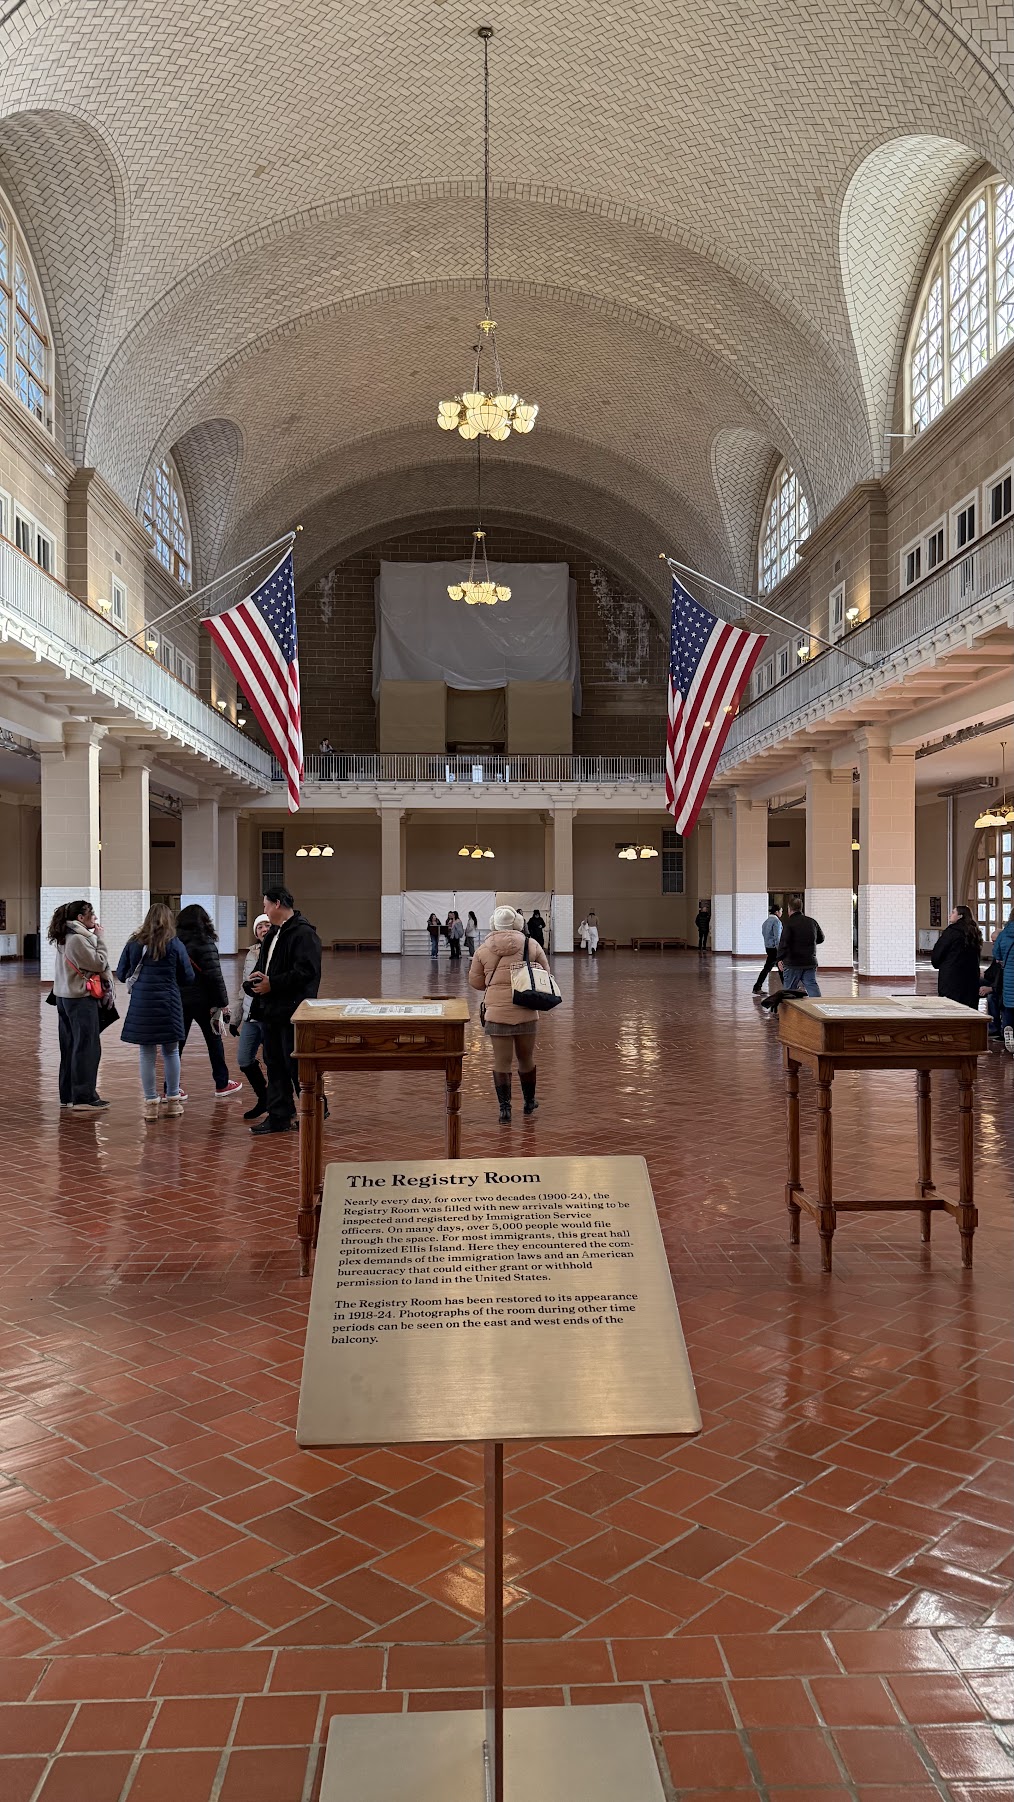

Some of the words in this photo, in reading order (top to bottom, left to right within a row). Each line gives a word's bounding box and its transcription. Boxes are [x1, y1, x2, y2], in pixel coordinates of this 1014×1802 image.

[346, 1175, 386, 1188] The
[391, 1173, 479, 1189] Registry
[483, 1171, 541, 1184] Room
[343, 1207, 389, 1216] Registry
[564, 1201, 604, 1210] waiting
[344, 1198, 379, 1207] Nearly
[411, 1197, 432, 1205] day,
[343, 1216, 393, 1226] inspected
[394, 1215, 414, 1224] and
[416, 1214, 470, 1224] registered
[471, 1214, 484, 1223] by
[486, 1212, 551, 1222] Immigration
[436, 1224, 464, 1233] days,
[492, 1222, 523, 1231] 5,000
[524, 1221, 559, 1231] people
[341, 1236, 384, 1245] through
[580, 1231, 608, 1240] great
[339, 1246, 398, 1257] epitomized
[401, 1245, 426, 1253] Ellis
[429, 1243, 465, 1252] Island.
[496, 1242, 520, 1251] they
[522, 1240, 588, 1250] encountered
[338, 1258, 361, 1267] plex
[363, 1256, 413, 1265] demands
[414, 1255, 426, 1264] of
[447, 1253, 515, 1263] immigration
[544, 1251, 564, 1260] and
[581, 1250, 634, 1259] American
[433, 1264, 462, 1273] could
[464, 1263, 498, 1272] either
[499, 1264, 529, 1273] grant
[544, 1261, 593, 1270] withhold
[336, 1277, 398, 1289] permission
[414, 1276, 439, 1284] land
[441, 1275, 452, 1284] in
[474, 1273, 511, 1283] United
[513, 1273, 551, 1281] States.
[334, 1300, 357, 1309] The
[359, 1299, 408, 1309] Registry
[410, 1298, 443, 1306] Room
[444, 1297, 465, 1305] has
[466, 1296, 493, 1305] been
[495, 1294, 542, 1303] restored
[574, 1294, 638, 1303] appearance
[333, 1312, 345, 1320] in
[348, 1310, 396, 1320] 1918-24.
[399, 1307, 470, 1319] Photographs
[472, 1307, 484, 1316] of
[486, 1307, 504, 1315] the
[537, 1305, 576, 1315] during
[577, 1304, 608, 1313] other
[609, 1303, 636, 1312] time
[332, 1323, 375, 1334] periods
[401, 1321, 414, 1330] be
[462, 1319, 481, 1328] the
[510, 1317, 532, 1326] and
[563, 1316, 590, 1325] ends
[592, 1315, 603, 1324] of
[604, 1315, 624, 1324] the
[331, 1335, 378, 1345] balcony.
